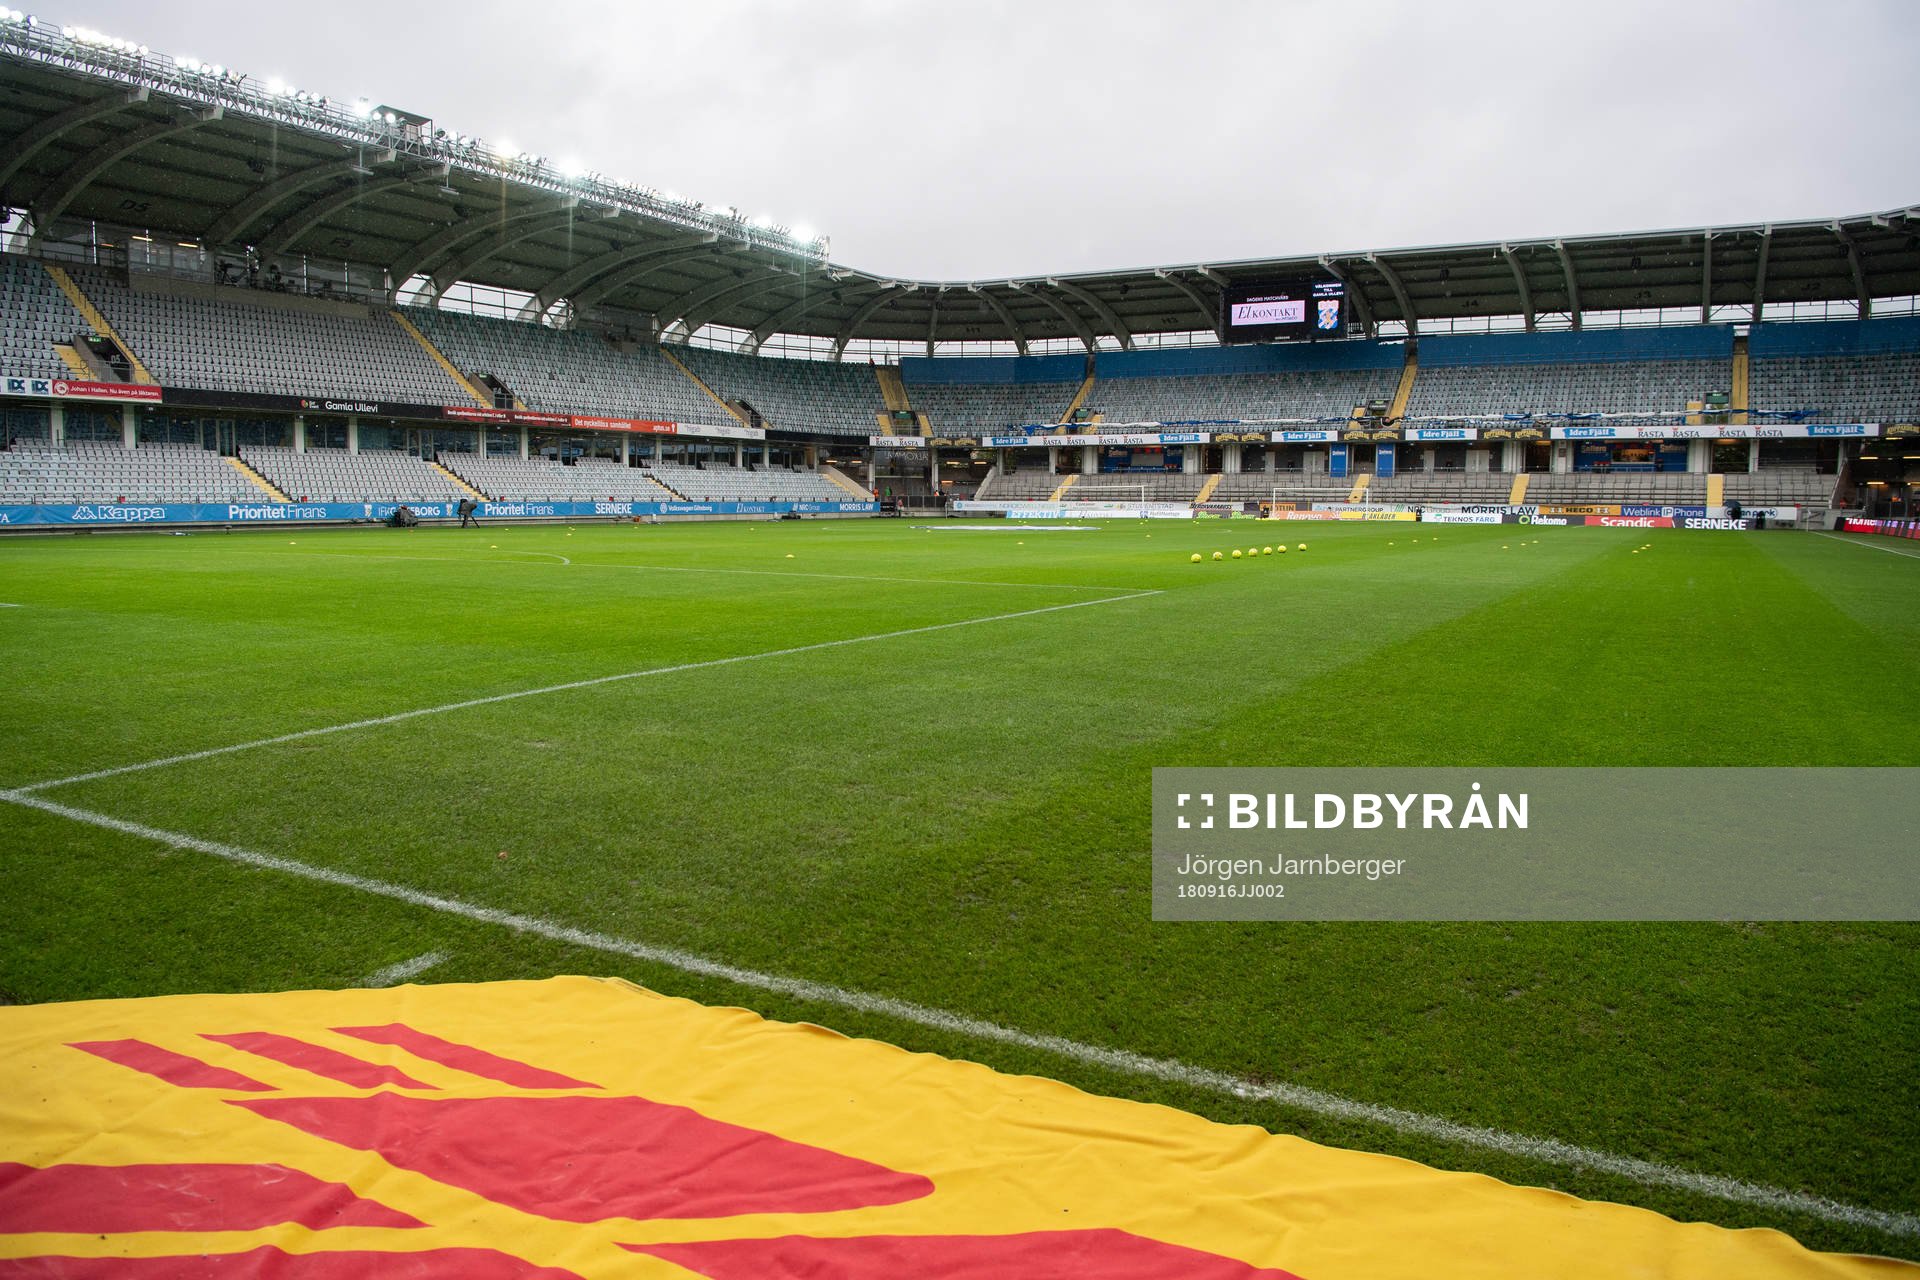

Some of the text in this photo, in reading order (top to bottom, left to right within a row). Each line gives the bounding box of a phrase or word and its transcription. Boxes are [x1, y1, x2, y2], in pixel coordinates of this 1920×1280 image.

[1252, 307, 1298, 319] KONTAKT
[325, 401, 353, 411] Gamla
[354, 402, 378, 413] Ullevi
[1441, 429, 1459, 438] Fjäll
[1813, 426, 1834, 434] Idre
[99, 505, 165, 521] Kappa
[228, 504, 327, 519] Prioritet Finans
[484, 503, 554, 515] Prioritet Finans
[595, 502, 632, 514] SERNEKE
[668, 504, 693, 512] Volkswagen
[840, 503, 861, 511] MORRIS
[861, 503, 873, 511] LAW
[1461, 506, 1536, 515] MORRIS LAW
[1623, 507, 1660, 517] Weblink
[1673, 508, 1704, 517] Phone
[1531, 515, 1567, 525] Rekomo
[1600, 516, 1655, 528] Scandic
[1684, 517, 1747, 530] SERNEKE
